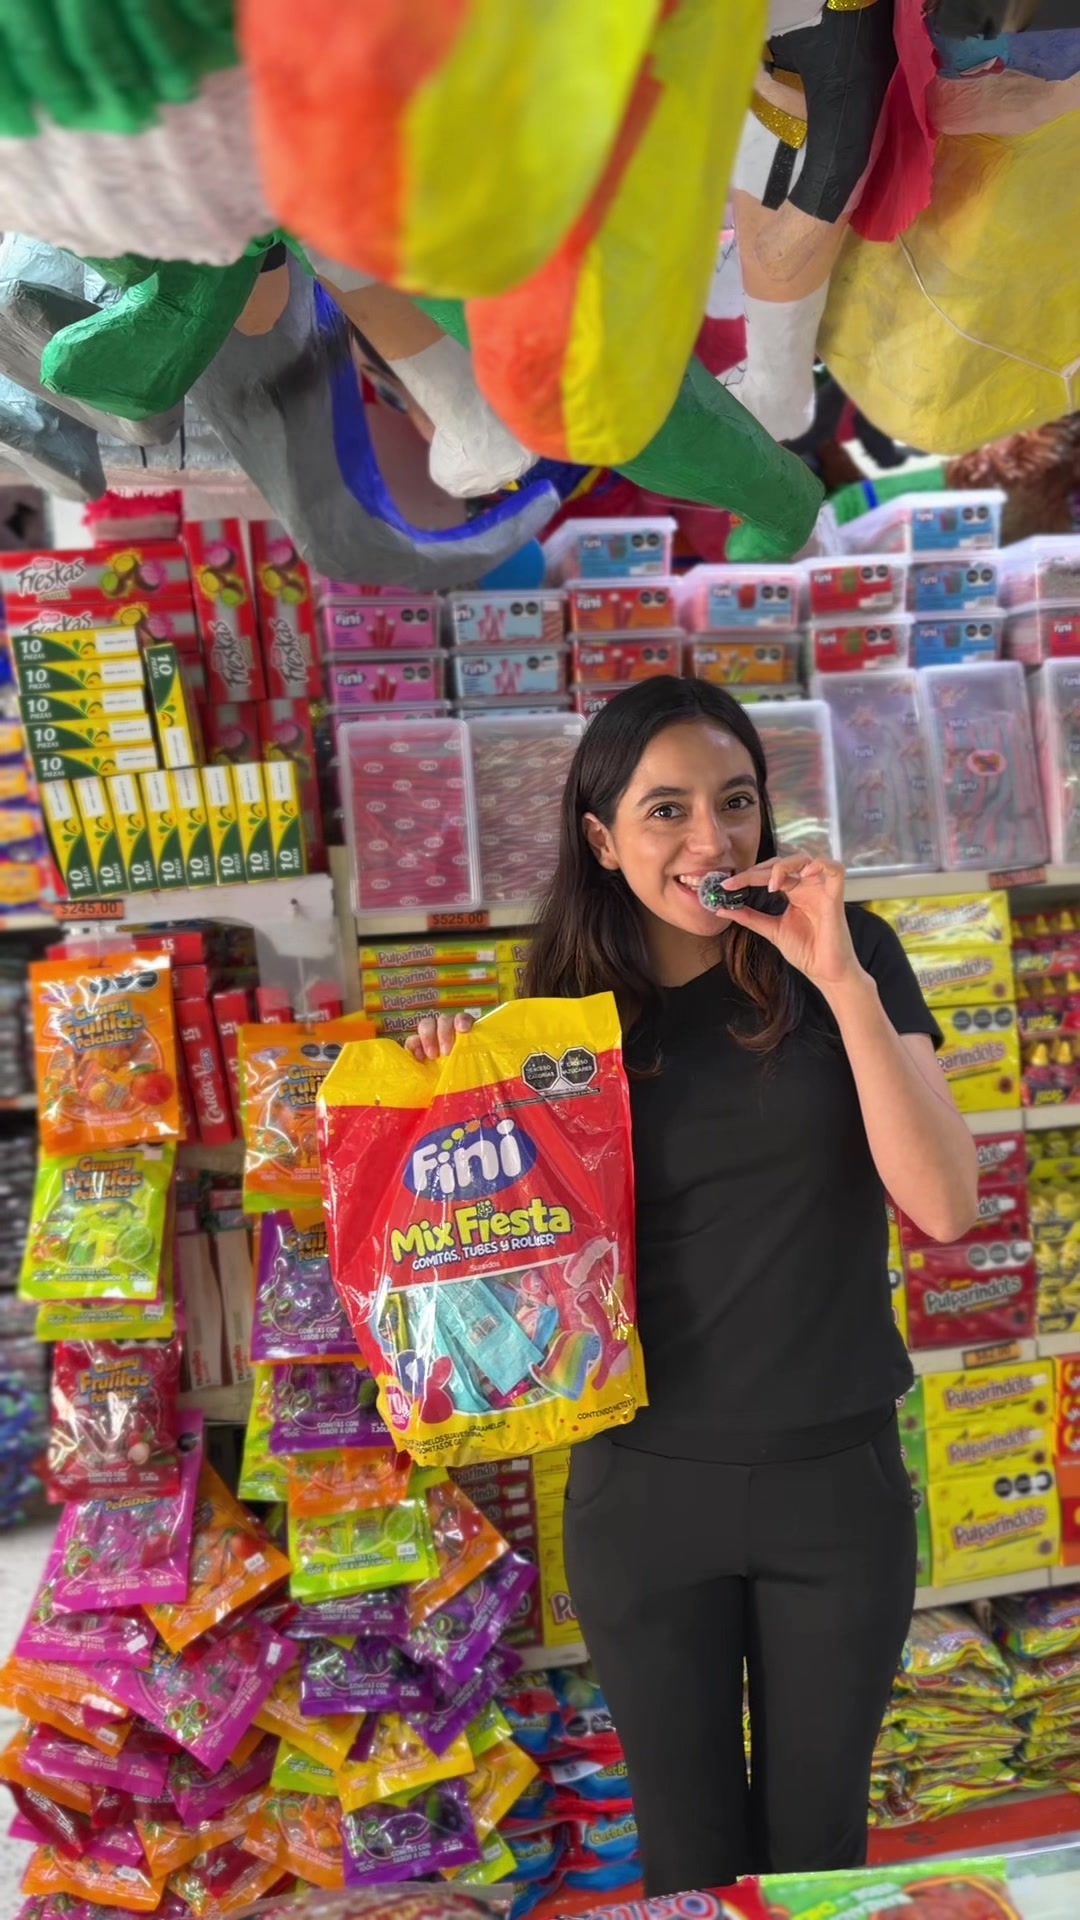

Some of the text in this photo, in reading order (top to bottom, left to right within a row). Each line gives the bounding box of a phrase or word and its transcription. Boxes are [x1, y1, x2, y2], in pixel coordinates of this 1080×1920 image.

[17, 559, 85, 596] Freskas
[335, 613, 361, 626] Fini
[20, 640, 42, 653] 10
[212, 620, 249, 687] Freskas
[273, 619, 308, 685] Freskas
[151, 657, 159, 678] PIEZAS
[157, 655, 172, 675] 10
[26, 670, 47, 683] 10
[337, 672, 362, 685] Fini
[27, 699, 49, 712] 10
[34, 728, 56, 741] 10
[40, 757, 62, 771] 10
[174, 858, 182, 878] PIEZAS
[191, 857, 204, 877] 10
[203, 855, 211, 876] PIEZAS
[222, 856, 235, 876] 10
[233, 854, 241, 873] PIEZAS
[251, 853, 264, 872] 10
[281, 850, 293, 870] 10
[292, 848, 300, 868] PIEZAS
[69, 869, 85, 889] 10
[82, 866, 92, 886] PIEZAS
[101, 866, 115, 886] 10
[113, 863, 123, 883] PIEZAS
[132, 864, 146, 884] 10
[144, 861, 153, 881] PIEZAS
[162, 861, 175, 881] 10
[61, 903, 118, 914] $245.00
[898, 904, 990, 932] Pulparindots
[432, 913, 484, 926] $525.00
[161, 939, 174, 950] 15
[378, 944, 435, 965] Pulparindo
[381, 967, 438, 988] Pulparindo
[382, 988, 440, 1009] Pulparindo
[183, 1028, 196, 1041] 15
[221, 1023, 233, 1035] 15
[413, 1118, 522, 1194] Fini
[391, 1198, 571, 1263] Mix Fiesta
[462, 1241, 498, 1257] TUBES
[509, 1234, 556, 1249] ROLLER
[926, 1278, 1021, 1313] Pulparindots
[578, 1406, 614, 1420] CONTENIDO
[613, 1401, 628, 1411] NETO
[953, 1507, 1046, 1547] Pulparindots
